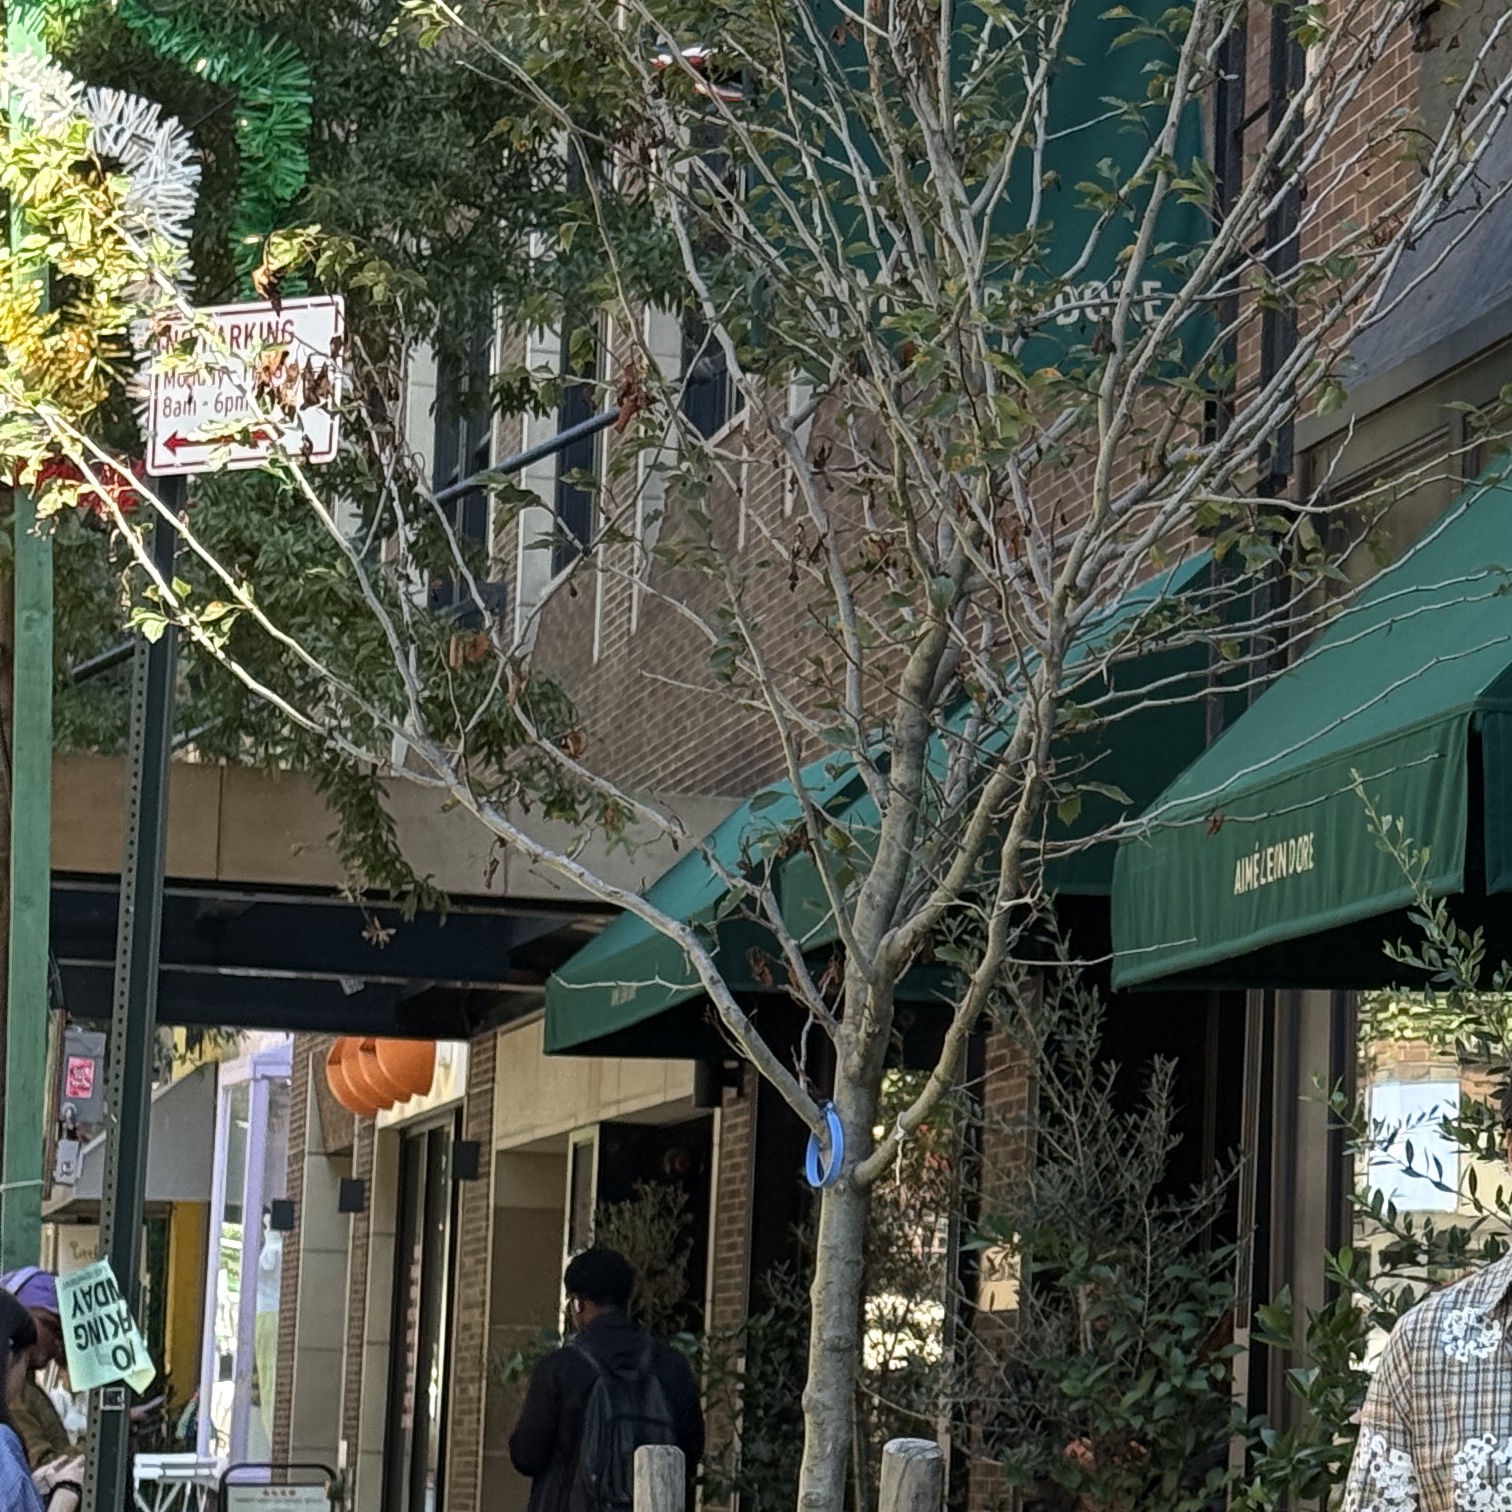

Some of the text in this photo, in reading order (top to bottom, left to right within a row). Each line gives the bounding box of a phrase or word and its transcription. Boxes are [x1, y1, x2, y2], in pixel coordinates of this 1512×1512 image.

[162, 396, 197, 419] 8am
[213, 391, 249, 418] 6pm
[1234, 841, 1261, 896] AIMÉ
